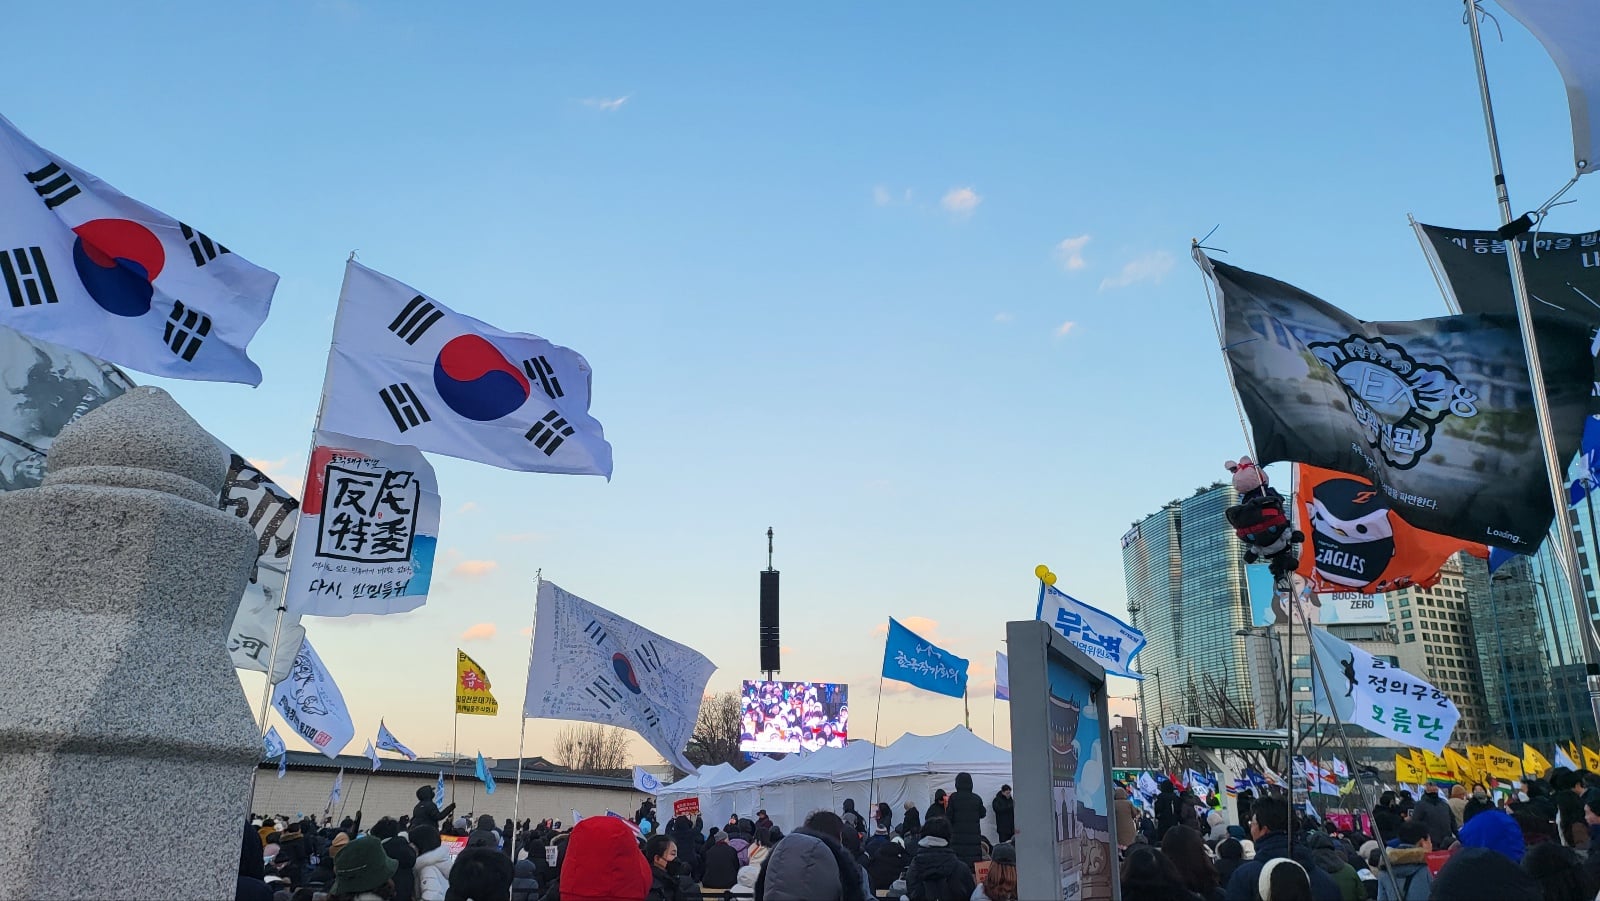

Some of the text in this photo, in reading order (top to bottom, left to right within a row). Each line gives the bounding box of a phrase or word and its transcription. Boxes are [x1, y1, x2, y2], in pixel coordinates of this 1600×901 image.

[1400, 490, 1439, 510] 파면한다.
[1486, 526, 1528, 546] Loading...
[1315, 548, 1366, 575] EAGLES
[352, 579, 410, 600] 반민특위
[1350, 600, 1374, 609] ZERO
[894, 650, 959, 685] 한국작가회의
[1368, 674, 1448, 708] 정의구현
[1371, 704, 1444, 742] 오름단
